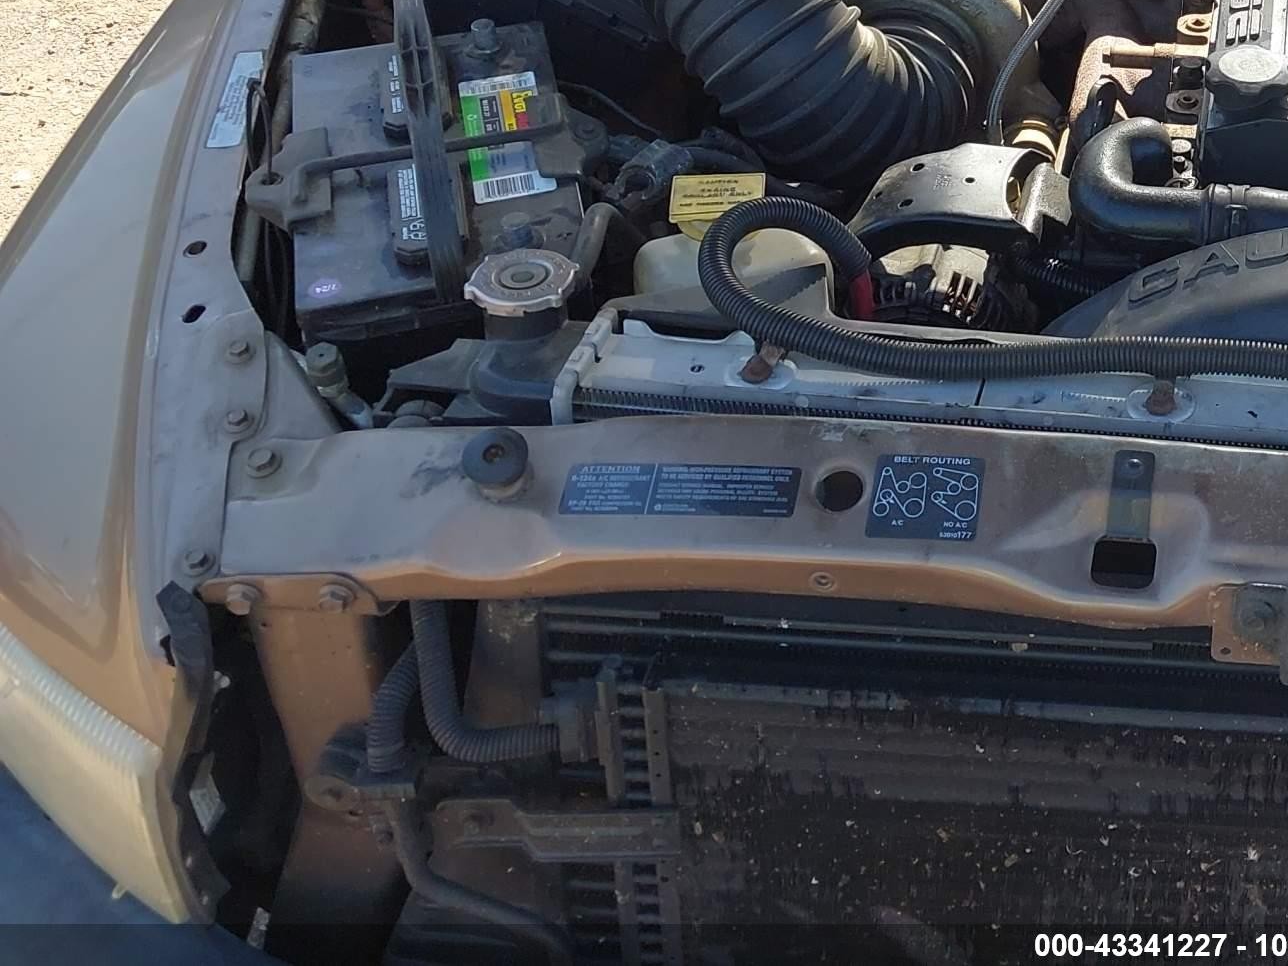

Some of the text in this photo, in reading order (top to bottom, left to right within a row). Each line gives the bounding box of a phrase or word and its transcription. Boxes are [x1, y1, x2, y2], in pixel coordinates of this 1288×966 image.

[894, 456, 971, 466] BELT ROUTING
[581, 465, 641, 474] ATTENTION
